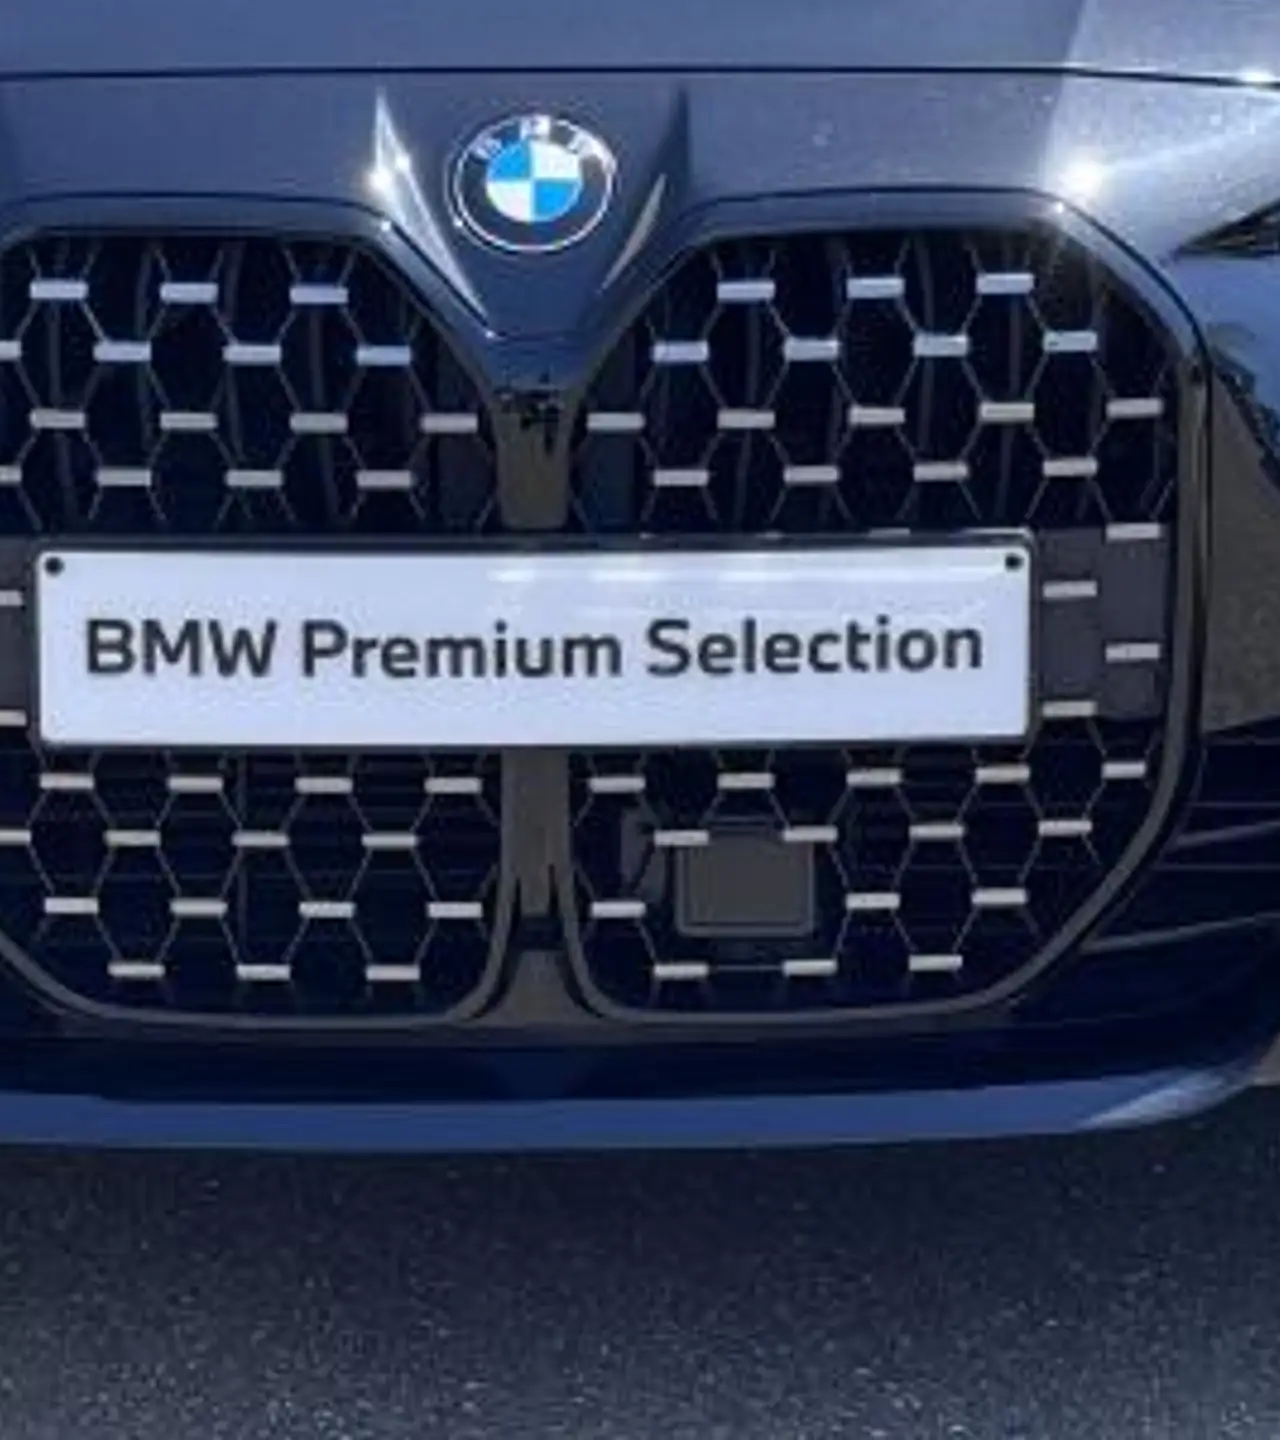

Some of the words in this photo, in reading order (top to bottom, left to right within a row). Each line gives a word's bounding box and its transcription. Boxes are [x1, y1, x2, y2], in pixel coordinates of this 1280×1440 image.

[85, 617, 279, 679] BMW
[300, 618, 623, 680] Premium
[645, 613, 984, 678] Selection
